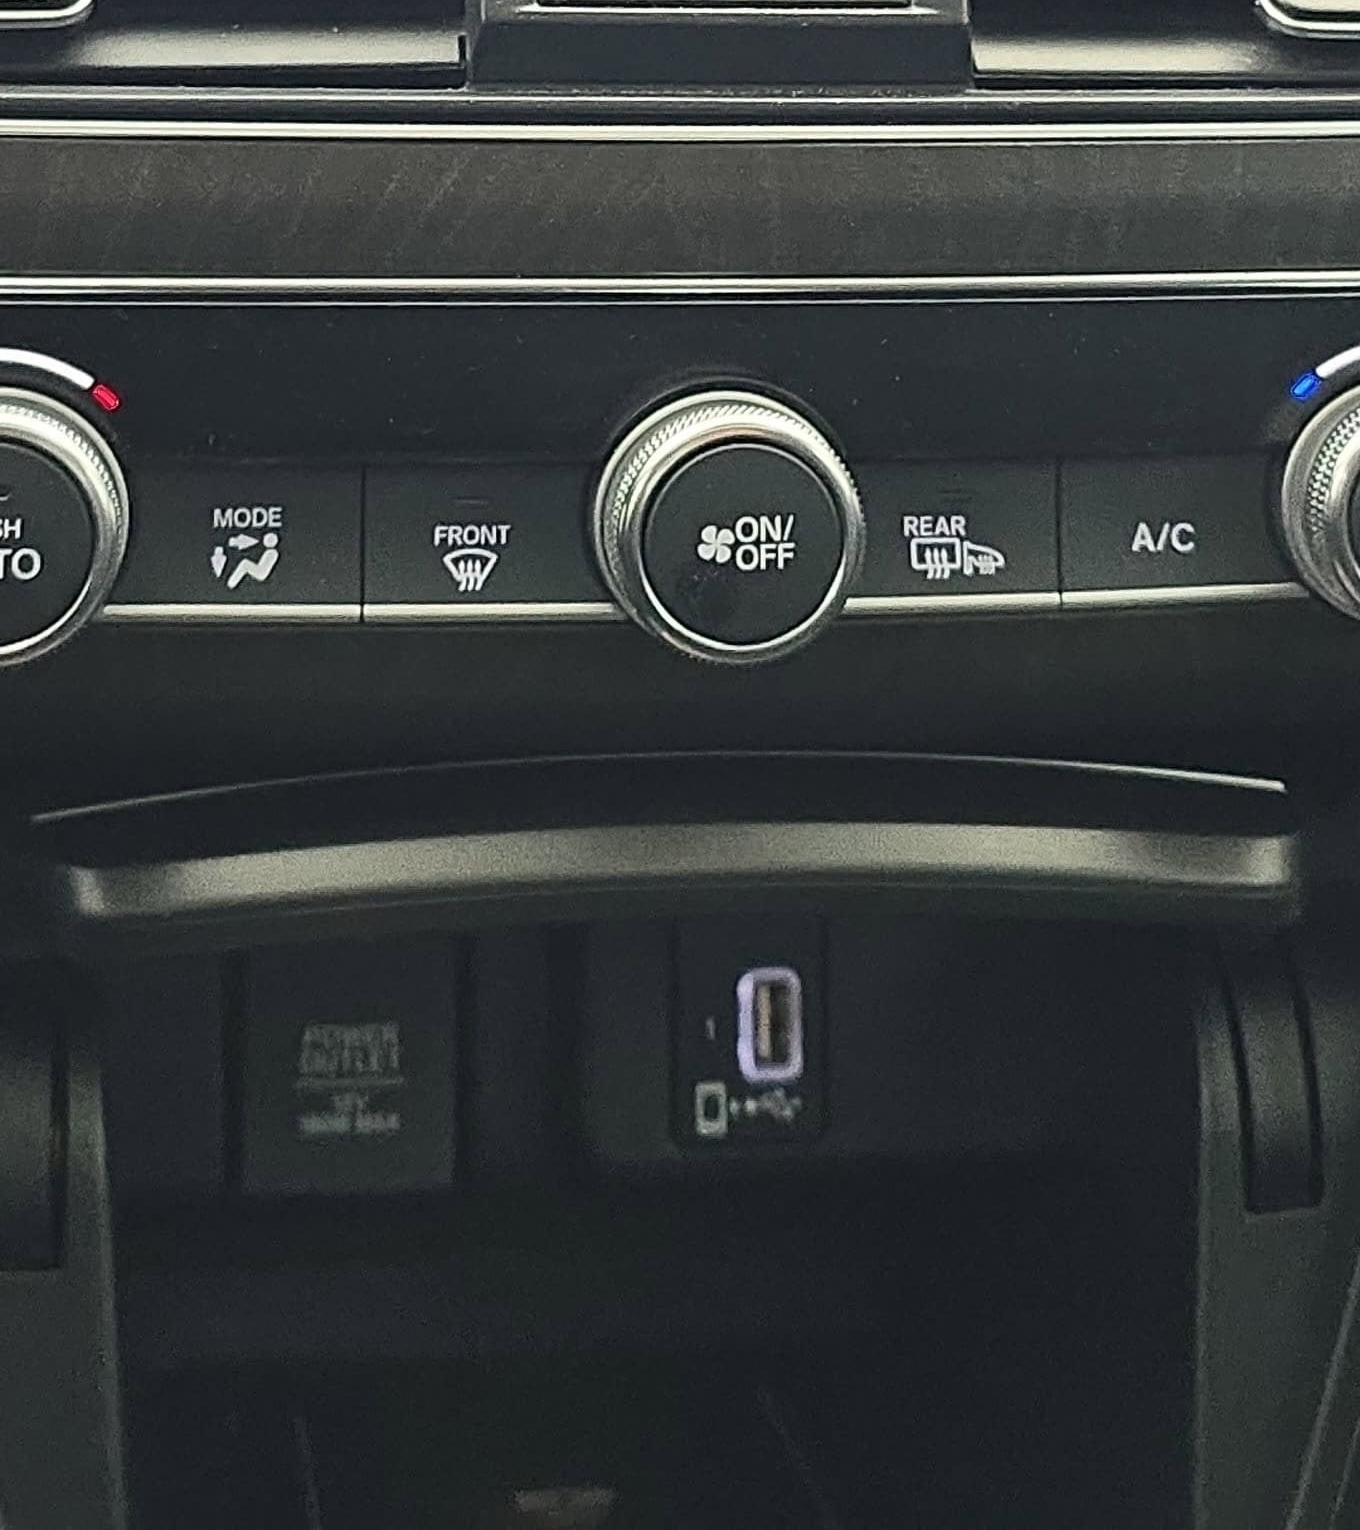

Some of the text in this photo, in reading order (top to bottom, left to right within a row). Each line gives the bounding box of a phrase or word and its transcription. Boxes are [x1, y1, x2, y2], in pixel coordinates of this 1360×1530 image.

[213, 507, 283, 530] MODE
[735, 514, 796, 543] ON/
[903, 515, 967, 538] REAR
[434, 524, 511, 547] FRONT
[1131, 522, 1196, 553] A/C
[736, 542, 797, 572] OFF
